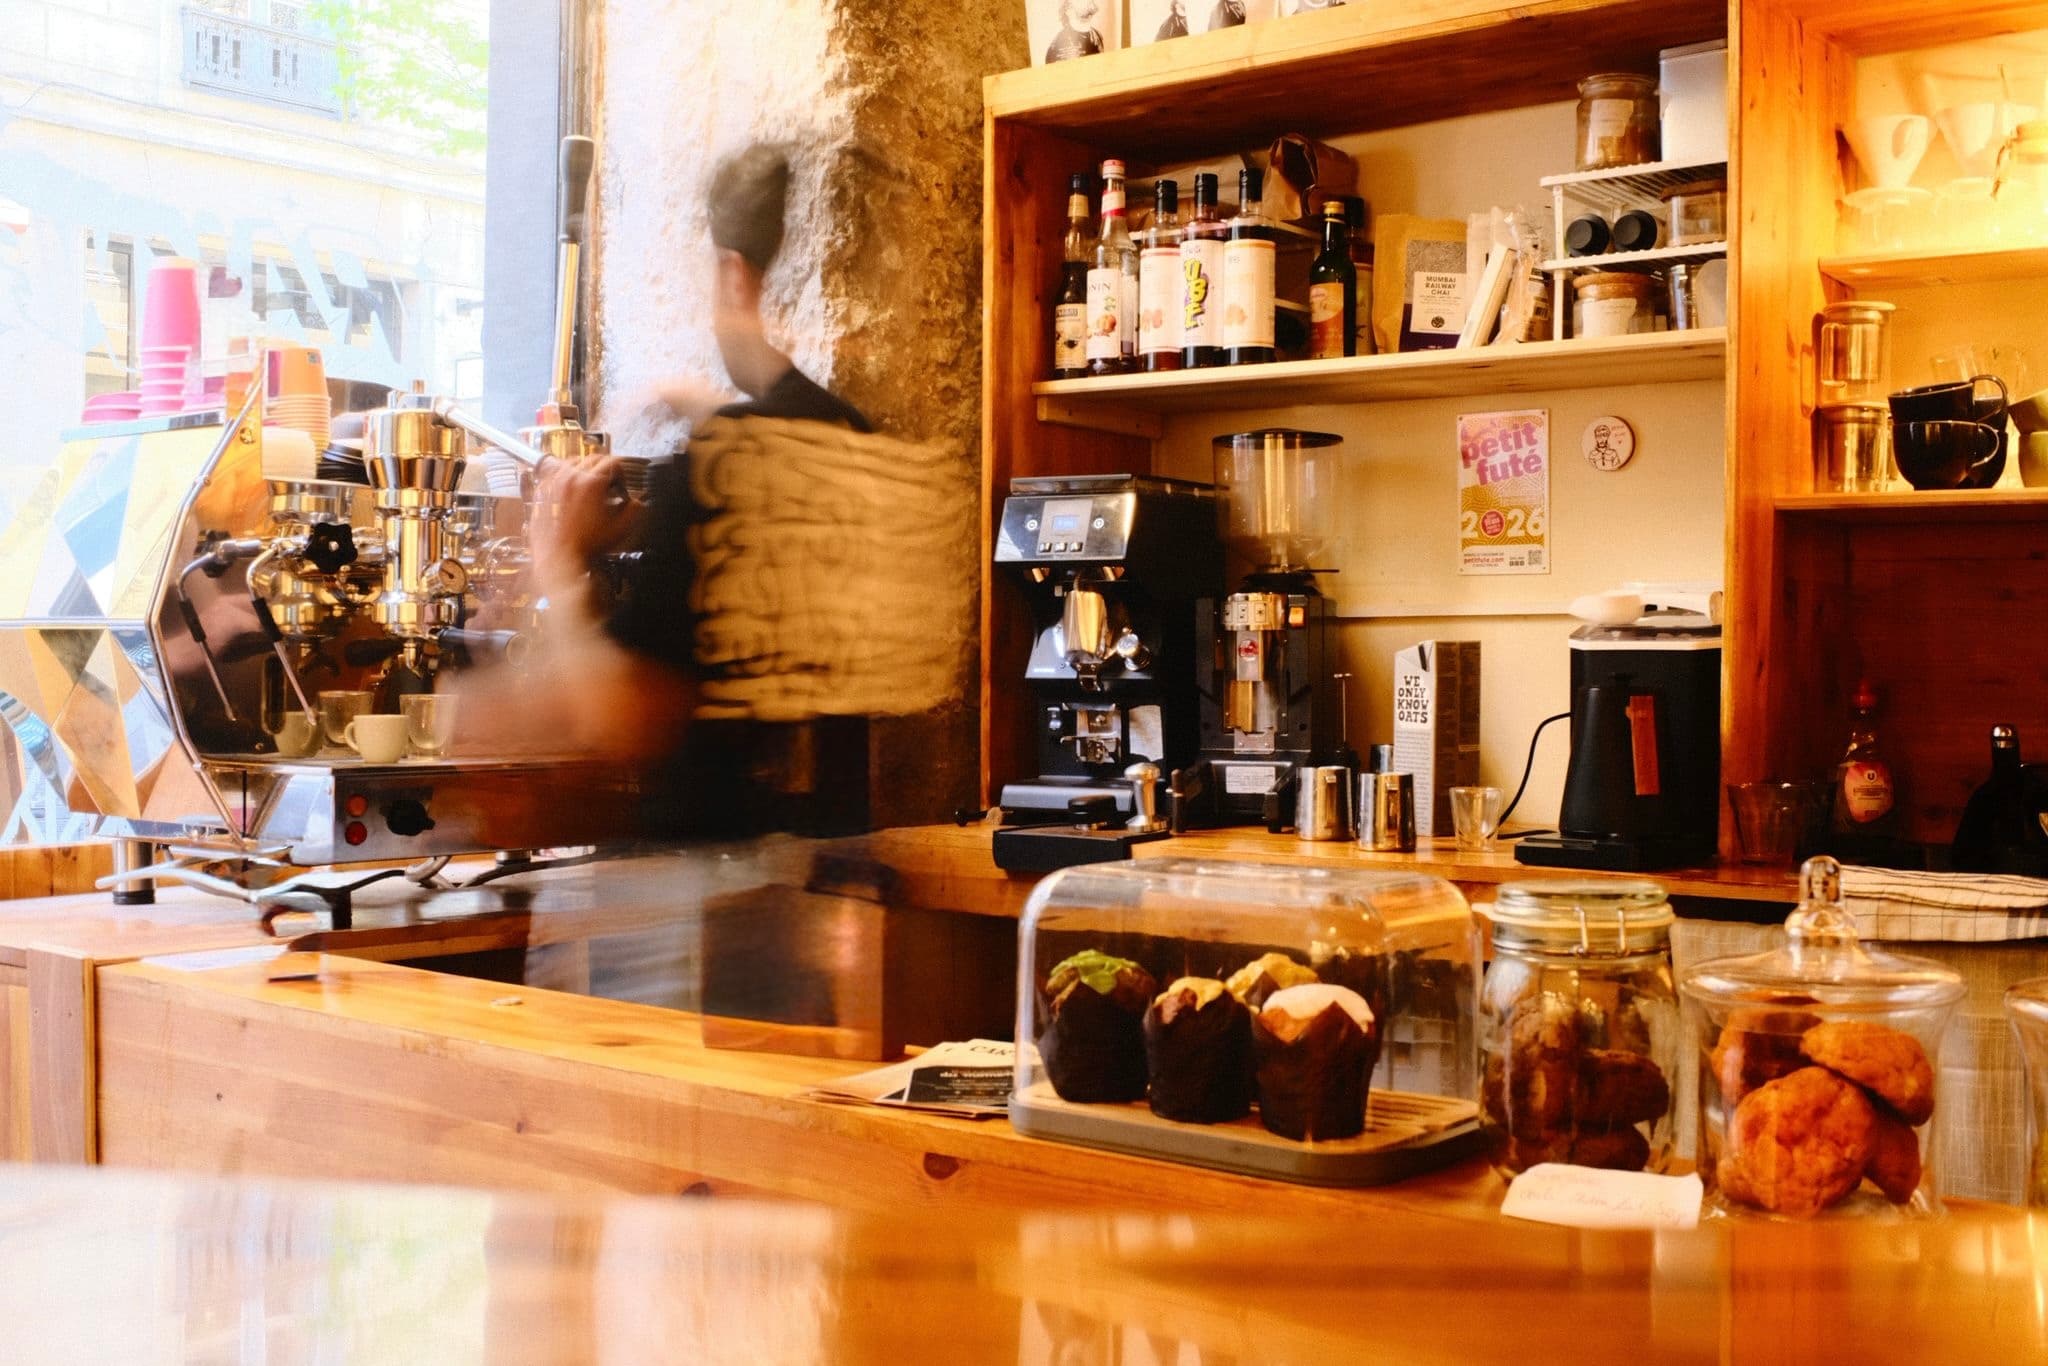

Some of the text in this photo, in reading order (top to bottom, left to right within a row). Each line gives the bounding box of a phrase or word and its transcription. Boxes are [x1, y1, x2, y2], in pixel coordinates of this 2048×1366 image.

[1184, 259, 1208, 330] UBE
[1461, 422, 1538, 469] petit
[1477, 448, 1542, 485] futé
[1404, 675, 1420, 687] WE
[1398, 687, 1426, 698] ONLY
[1397, 698, 1429, 710] KNOW
[1398, 710, 1428, 724] OATS
